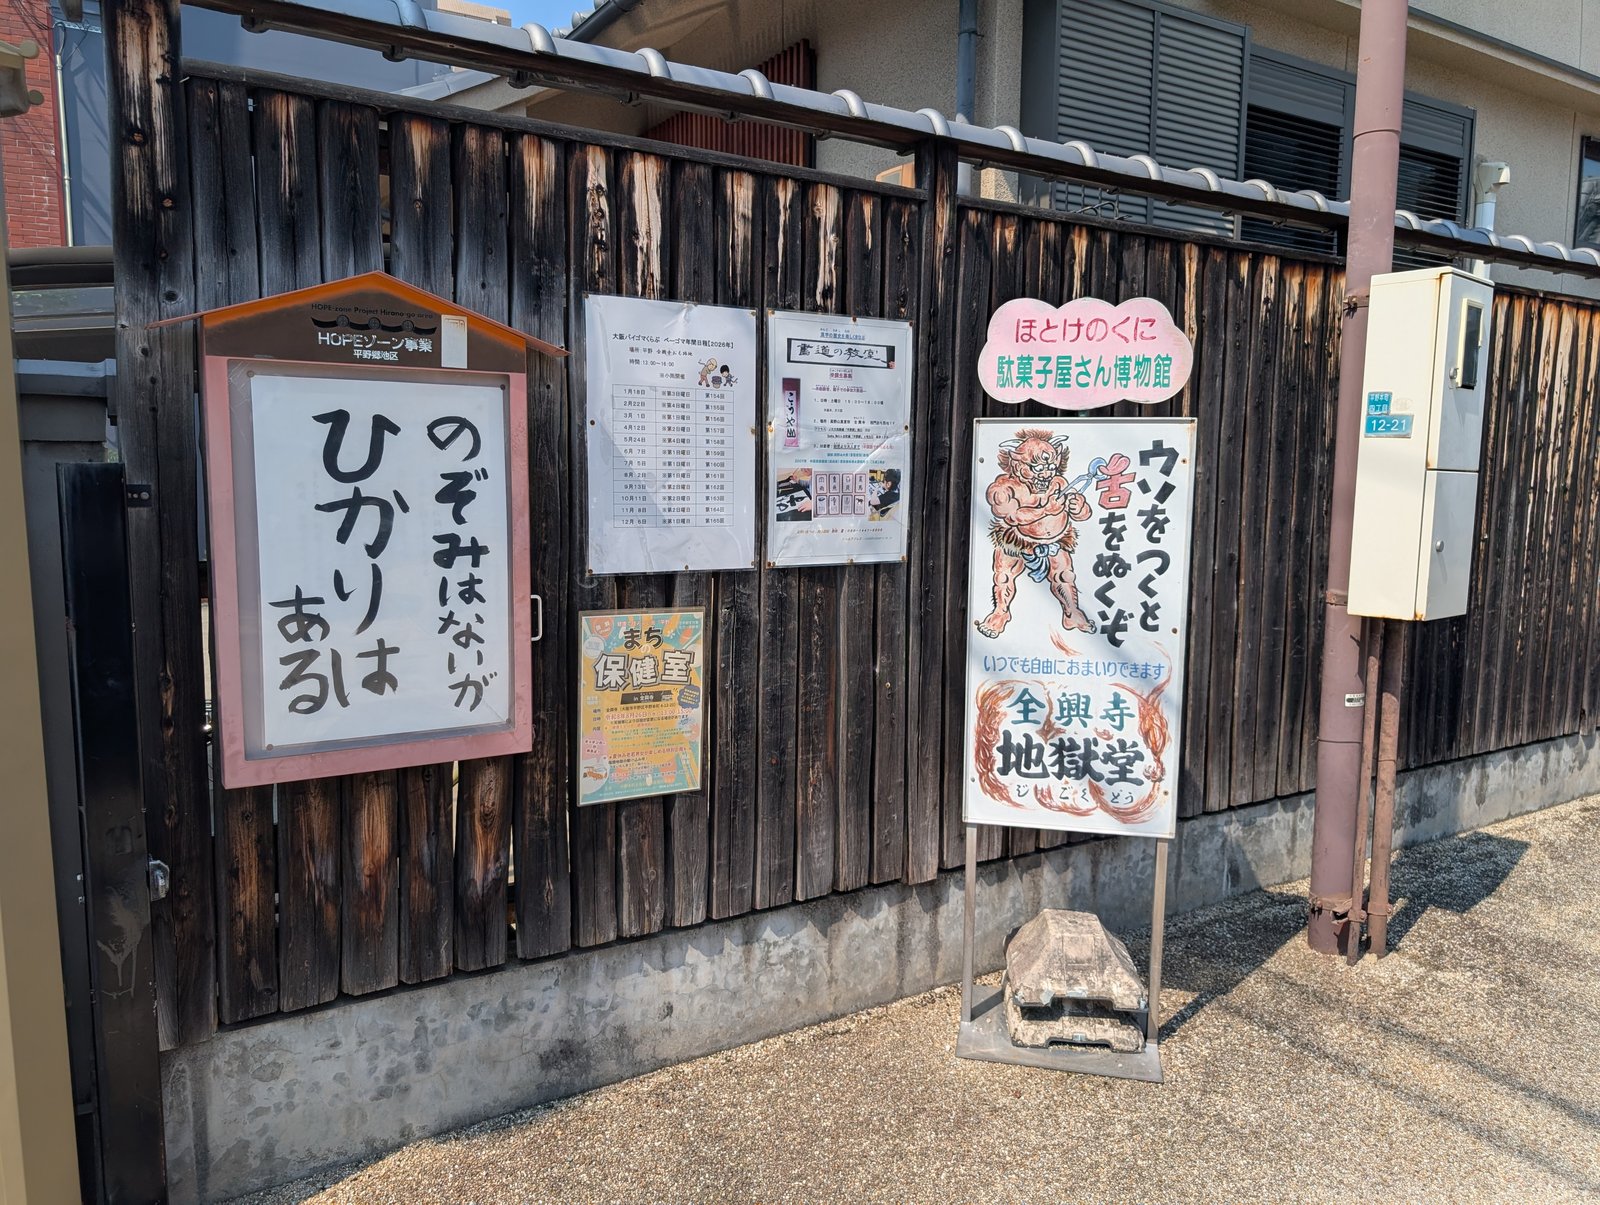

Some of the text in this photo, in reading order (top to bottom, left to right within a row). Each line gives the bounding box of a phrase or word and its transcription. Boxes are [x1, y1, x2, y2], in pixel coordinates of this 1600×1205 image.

[354, 306, 379, 316] Project
[380, 309, 405, 317] Hirano
[1015, 316, 1158, 344] ほとけのくに
[318, 332, 433, 353] HOPEゾーン事業
[996, 354, 1173, 390] 駄菓子屋さん博物館
[1371, 419, 1407, 431] 12-21
[1092, 453, 1137, 649] 舌をぬくぞ
[1136, 439, 1181, 633] ウソをつくと
[311, 408, 410, 708] ひかりは
[426, 415, 498, 713] のぞみはないが
[268, 584, 331, 715] ある
[593, 649, 695, 691] 保健室
[983, 655, 1166, 681] いつでも自由におまいりできます
[1006, 687, 1136, 732] 全興寺
[996, 729, 1145, 786] 地獄堂
